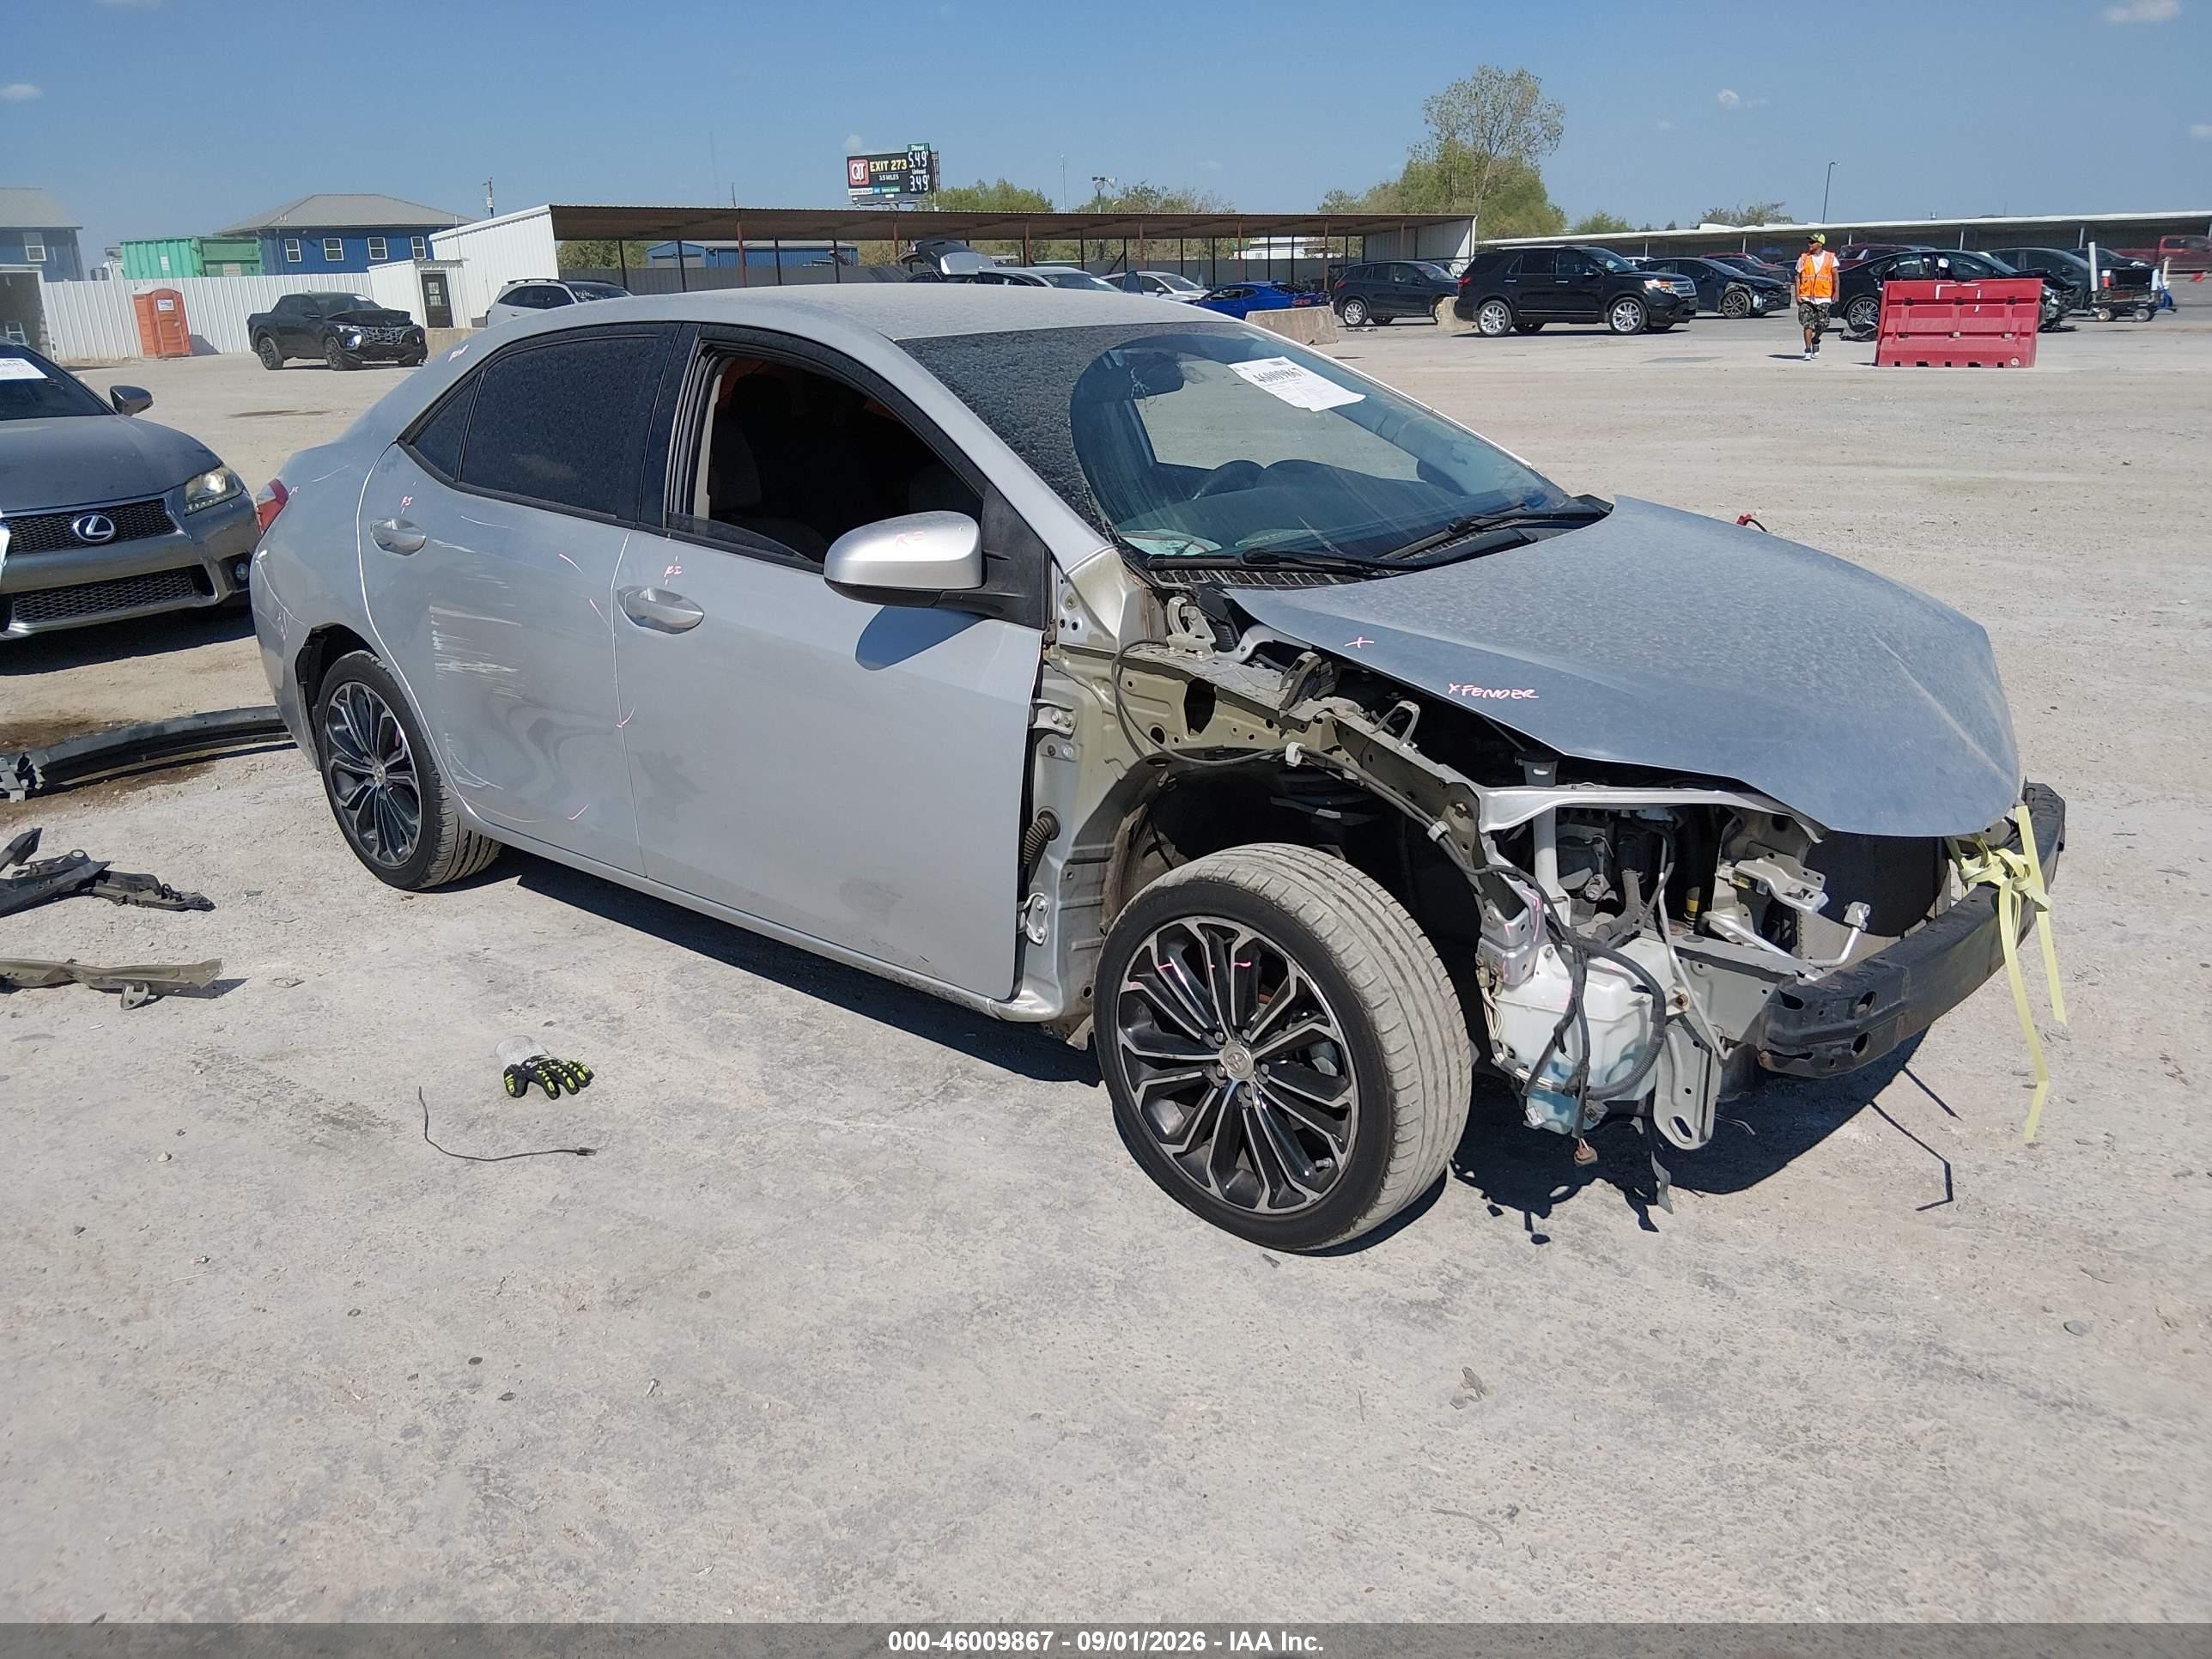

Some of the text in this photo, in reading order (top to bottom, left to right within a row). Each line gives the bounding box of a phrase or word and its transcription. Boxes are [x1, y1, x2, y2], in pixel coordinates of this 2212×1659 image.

[851, 163, 866, 181] QT
[870, 159, 907, 172] EXIT 273
